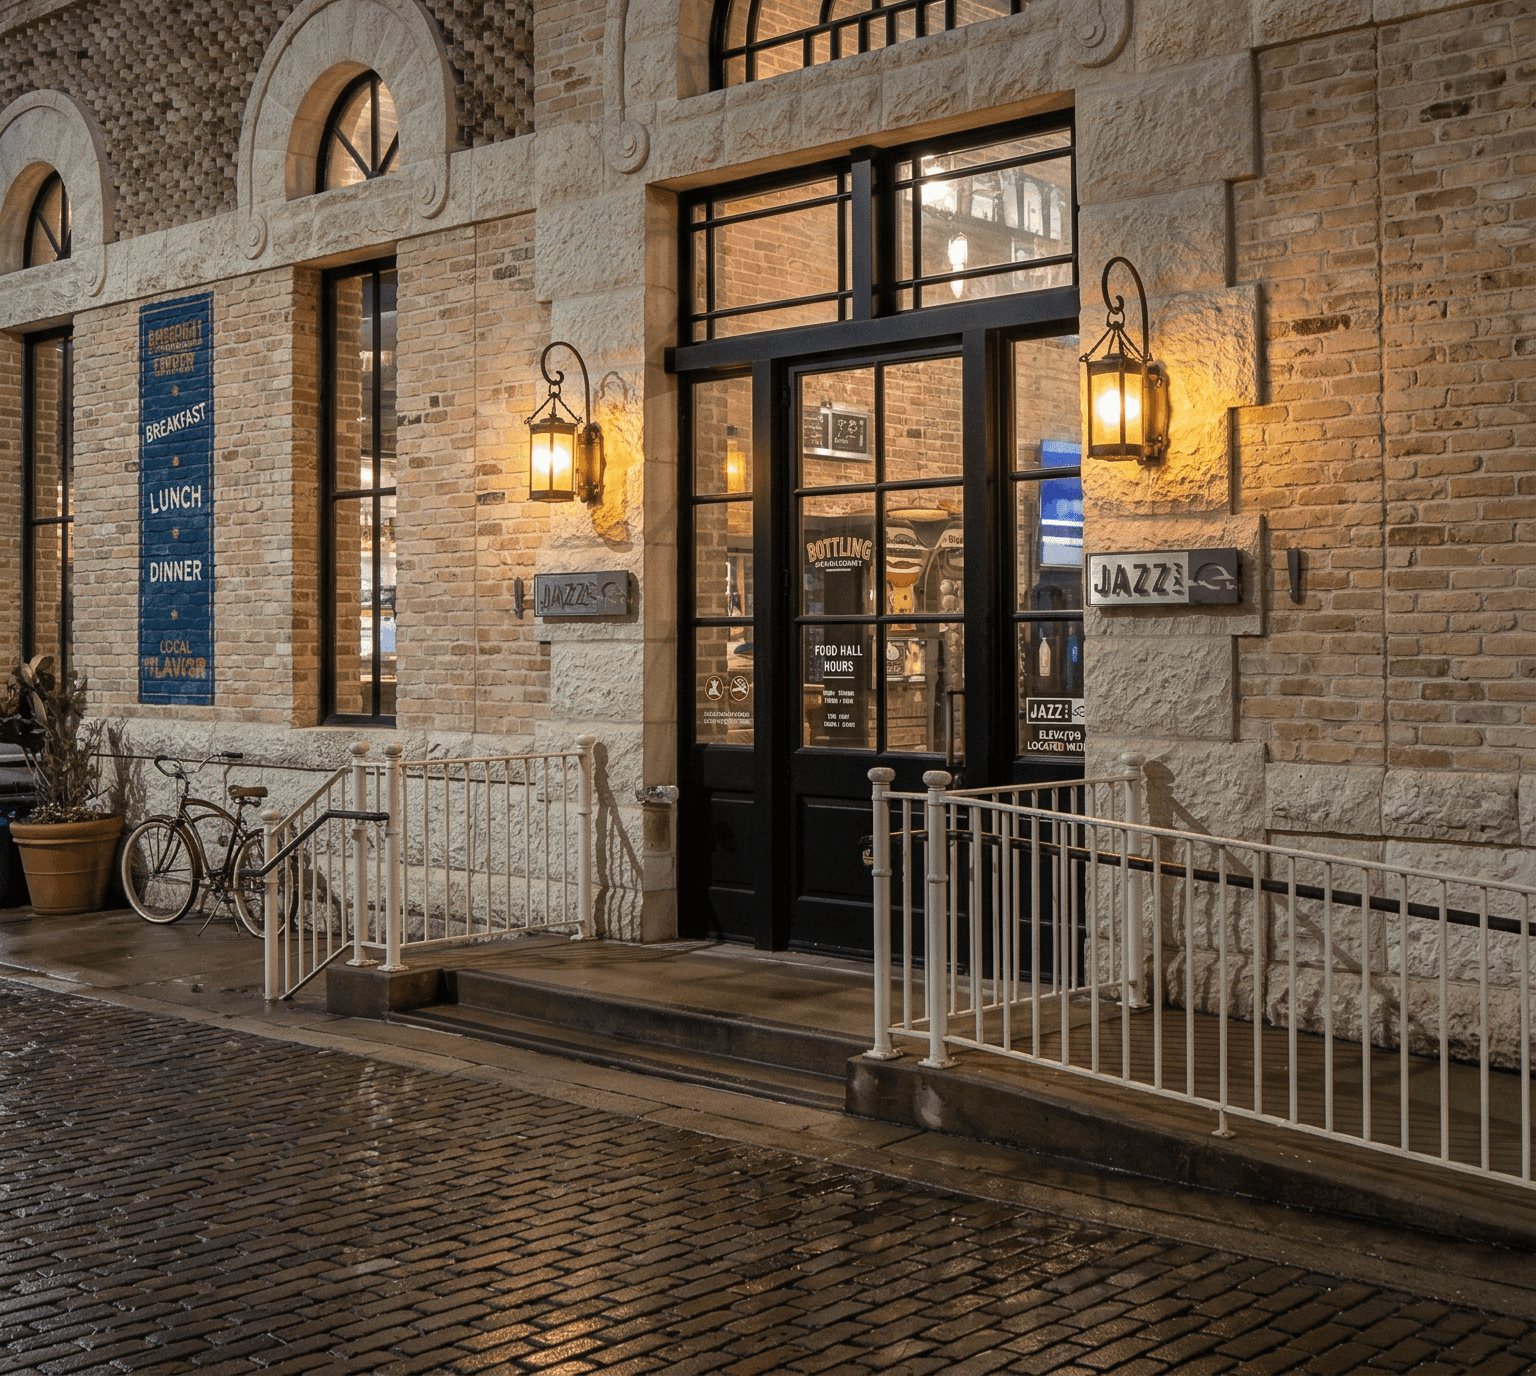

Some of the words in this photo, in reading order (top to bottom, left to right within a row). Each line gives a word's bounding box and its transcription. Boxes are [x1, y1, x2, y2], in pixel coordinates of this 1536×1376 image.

[145, 402, 206, 443] BREAKFAST
[150, 485, 202, 514] LUNCH
[806, 536, 873, 563] BOTTLING
[150, 560, 202, 582] DINNER
[160, 640, 193, 654] LOCAL
[814, 645, 838, 656] FOOD
[840, 645, 863, 656] HALL
[824, 661, 854, 672] HOURS
[1030, 704, 1063, 719] JAZZ
